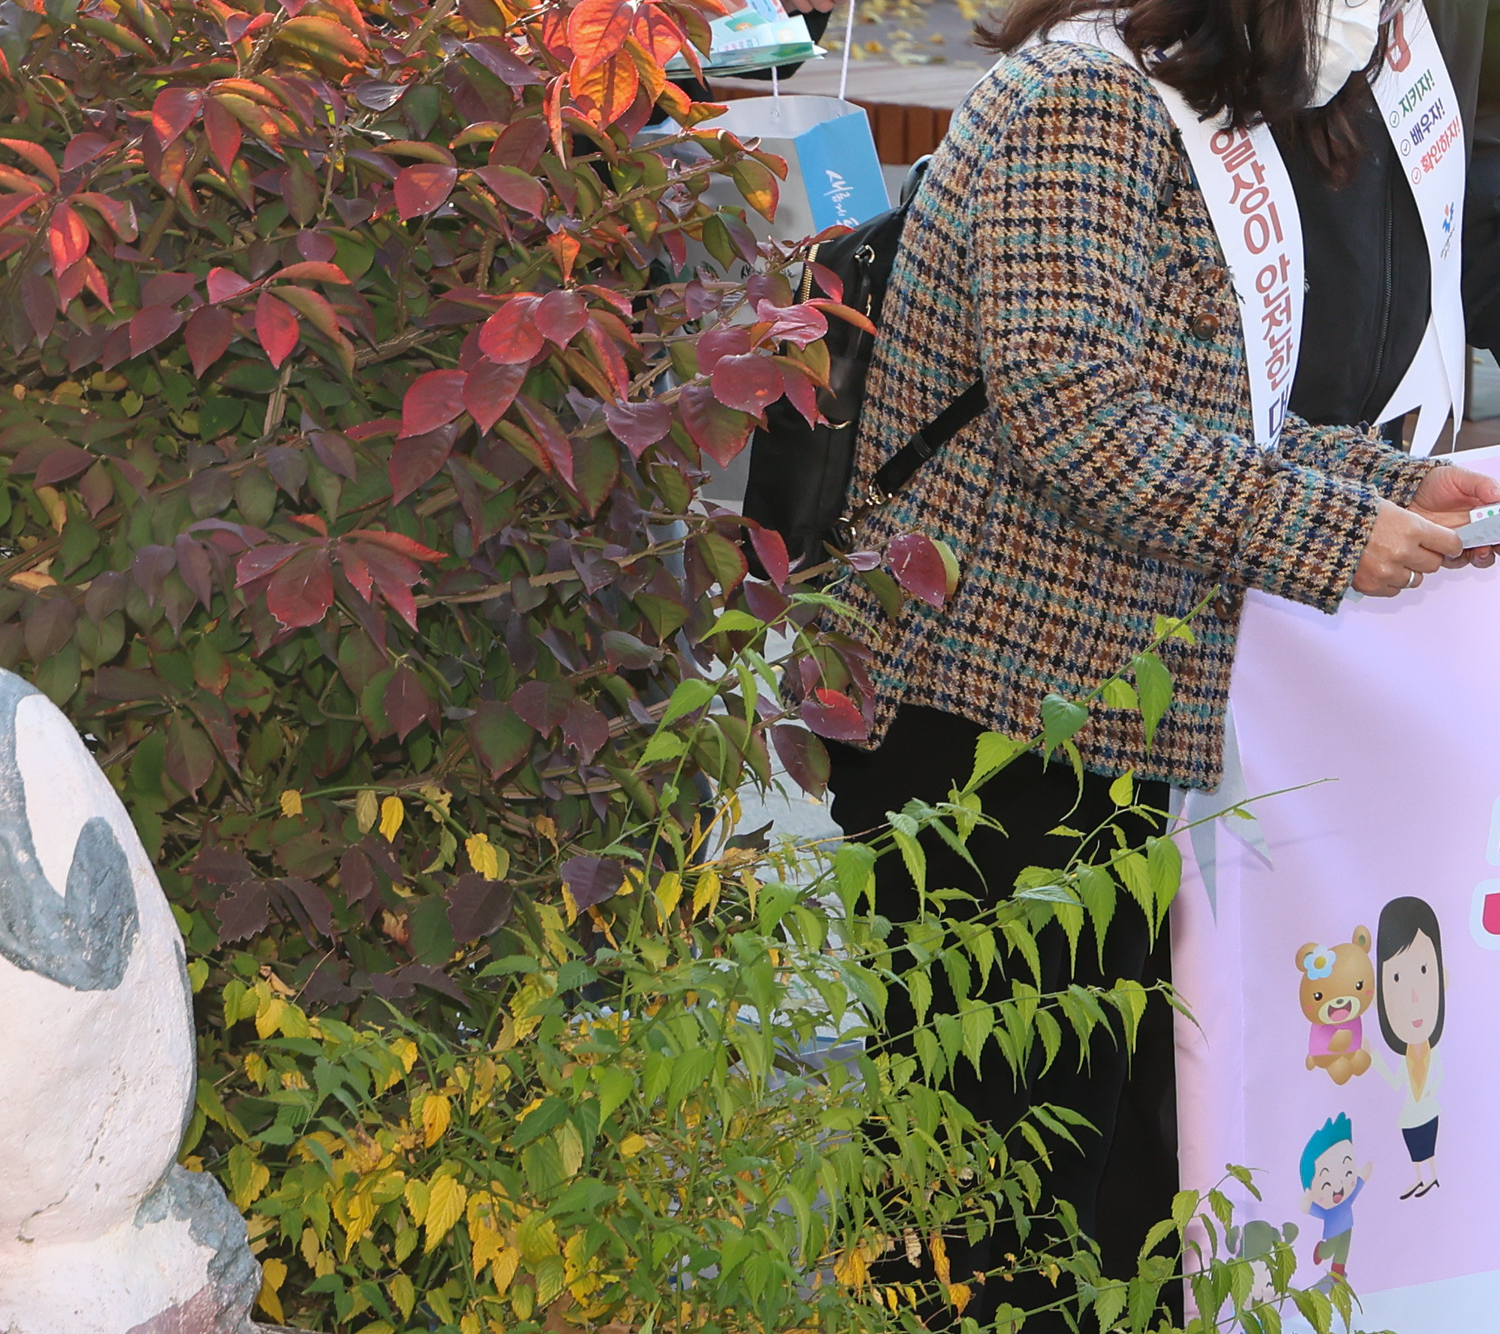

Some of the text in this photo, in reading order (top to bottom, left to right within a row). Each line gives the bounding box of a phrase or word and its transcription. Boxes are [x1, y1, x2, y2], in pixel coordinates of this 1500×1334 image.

[1399, 70, 1437, 118] 지키자!
[1410, 98, 1446, 148] 배우자!
[1419, 114, 1462, 175] 확인하자!
[1255, 253, 1294, 392] 안전한
